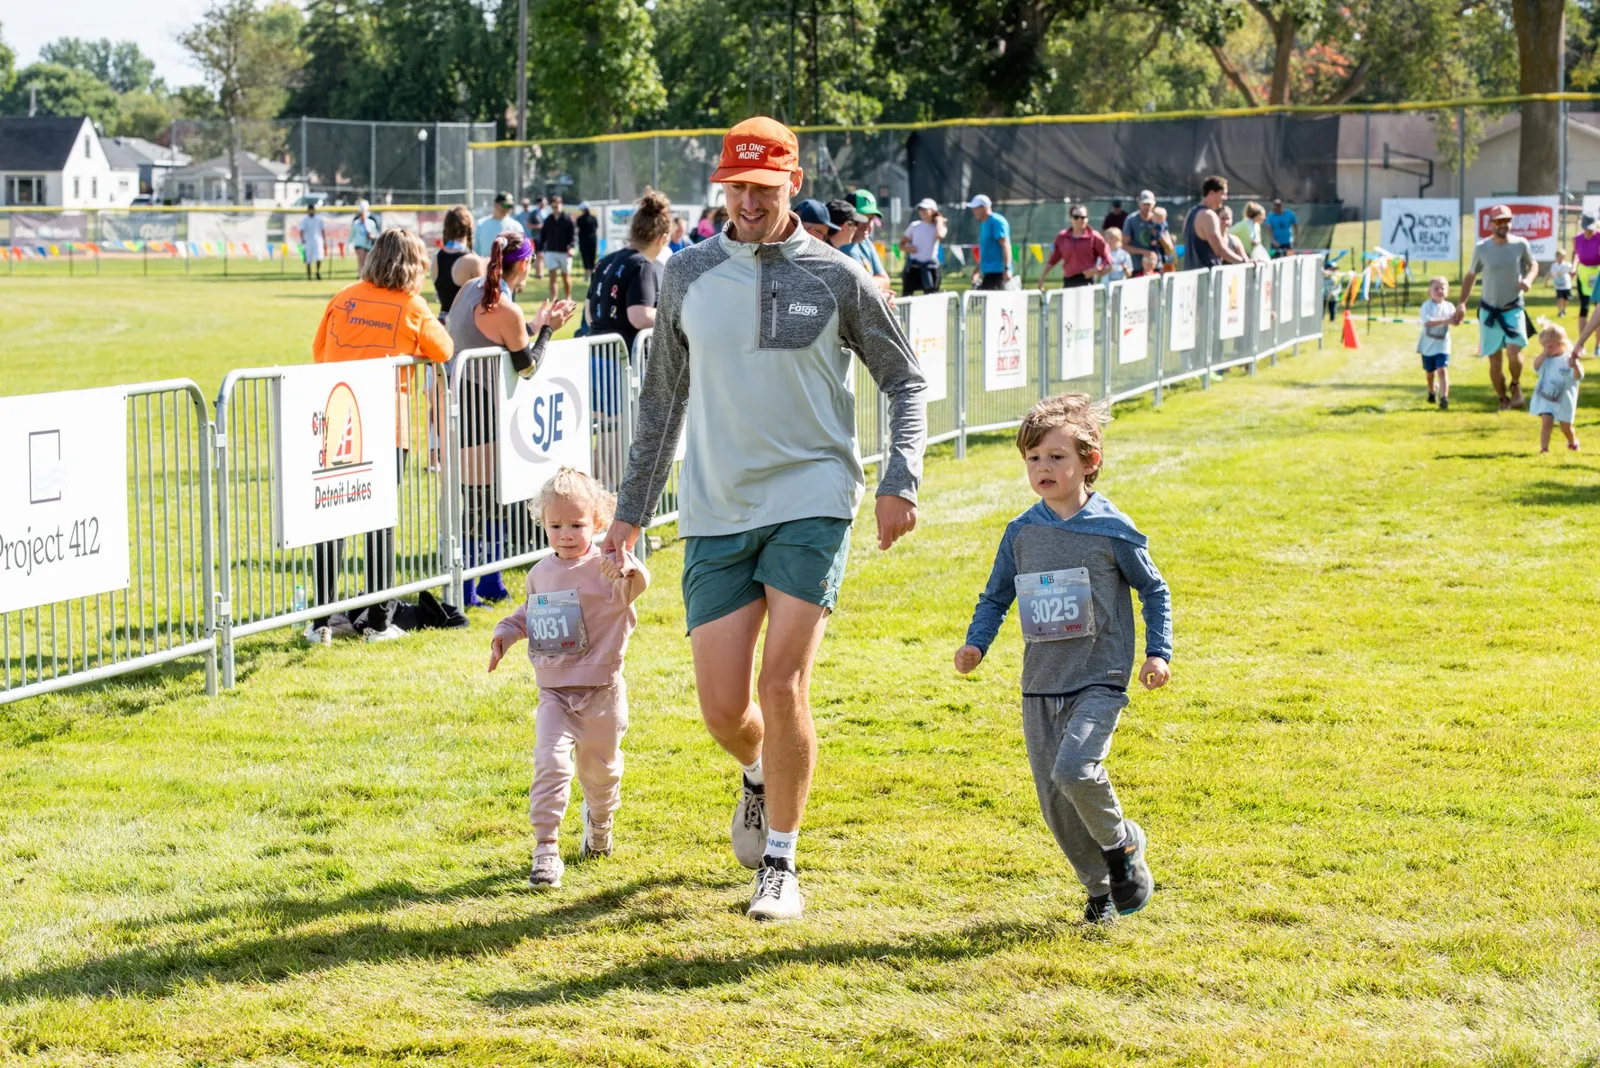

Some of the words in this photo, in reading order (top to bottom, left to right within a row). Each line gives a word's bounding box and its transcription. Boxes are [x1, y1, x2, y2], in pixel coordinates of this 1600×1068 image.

[736, 143, 747, 152] GO
[749, 143, 766, 153] ONE
[738, 151, 760, 160] MORE
[1418, 215, 1452, 228] ACTION
[1418, 231, 1450, 244] REALTY
[788, 302, 818, 316] Fargo
[312, 411, 329, 440] City
[532, 392, 564, 452] SJE
[315, 481, 345, 509] Detroit
[346, 479, 372, 503] Lakes
[69, 516, 101, 557] 412
[1031, 595, 1080, 624] 3025
[531, 615, 569, 640] 3031
